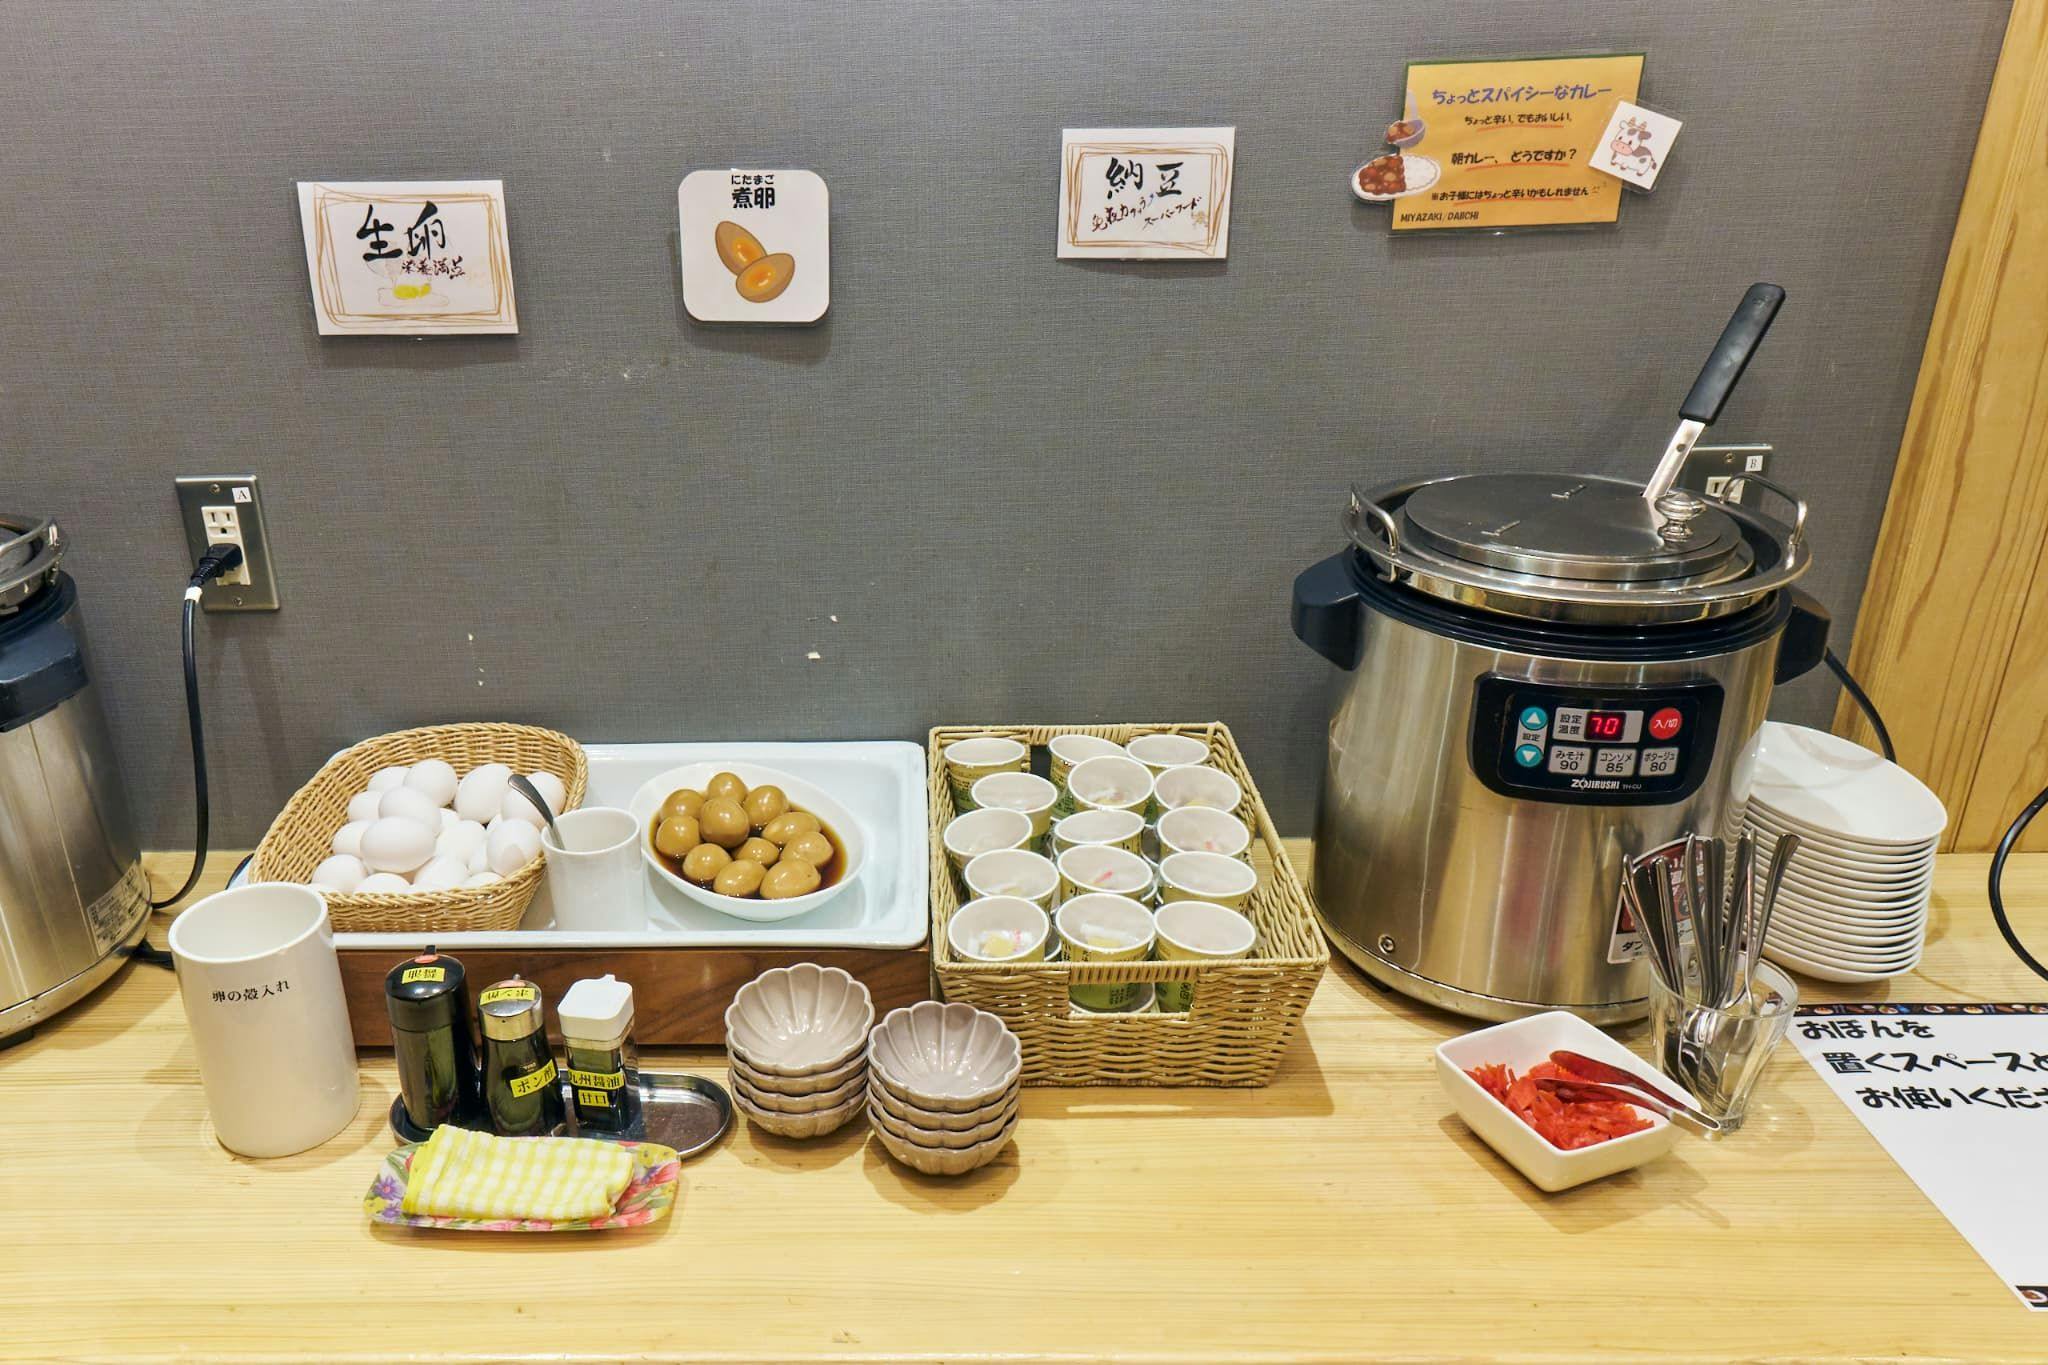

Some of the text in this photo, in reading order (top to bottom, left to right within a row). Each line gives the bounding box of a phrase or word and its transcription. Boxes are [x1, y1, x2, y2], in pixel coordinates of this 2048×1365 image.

[1432, 84, 1612, 105] ちょっとスパイシーなカレー
[731, 174, 775, 185] にたまご
[1105, 157, 1184, 199] 納豆
[731, 187, 776, 209] 煮卵
[356, 200, 447, 262] 生卵
[238, 489, 248, 500] A
[1559, 713, 1583, 724] 設定
[1558, 724, 1580, 735] 温度
[1592, 717, 1620, 735] 70
[1522, 733, 1541, 742] 設定
[1555, 751, 1585, 761] みそ汁
[1600, 753, 1633, 762] コンソメ
[1560, 760, 1579, 771] 90
[1605, 763, 1625, 773] 85
[1650, 761, 1668, 772] 80
[1570, 778, 1621, 791] ZOJIRUSHI
[212, 980, 290, 1003] 卵の殻入れ
